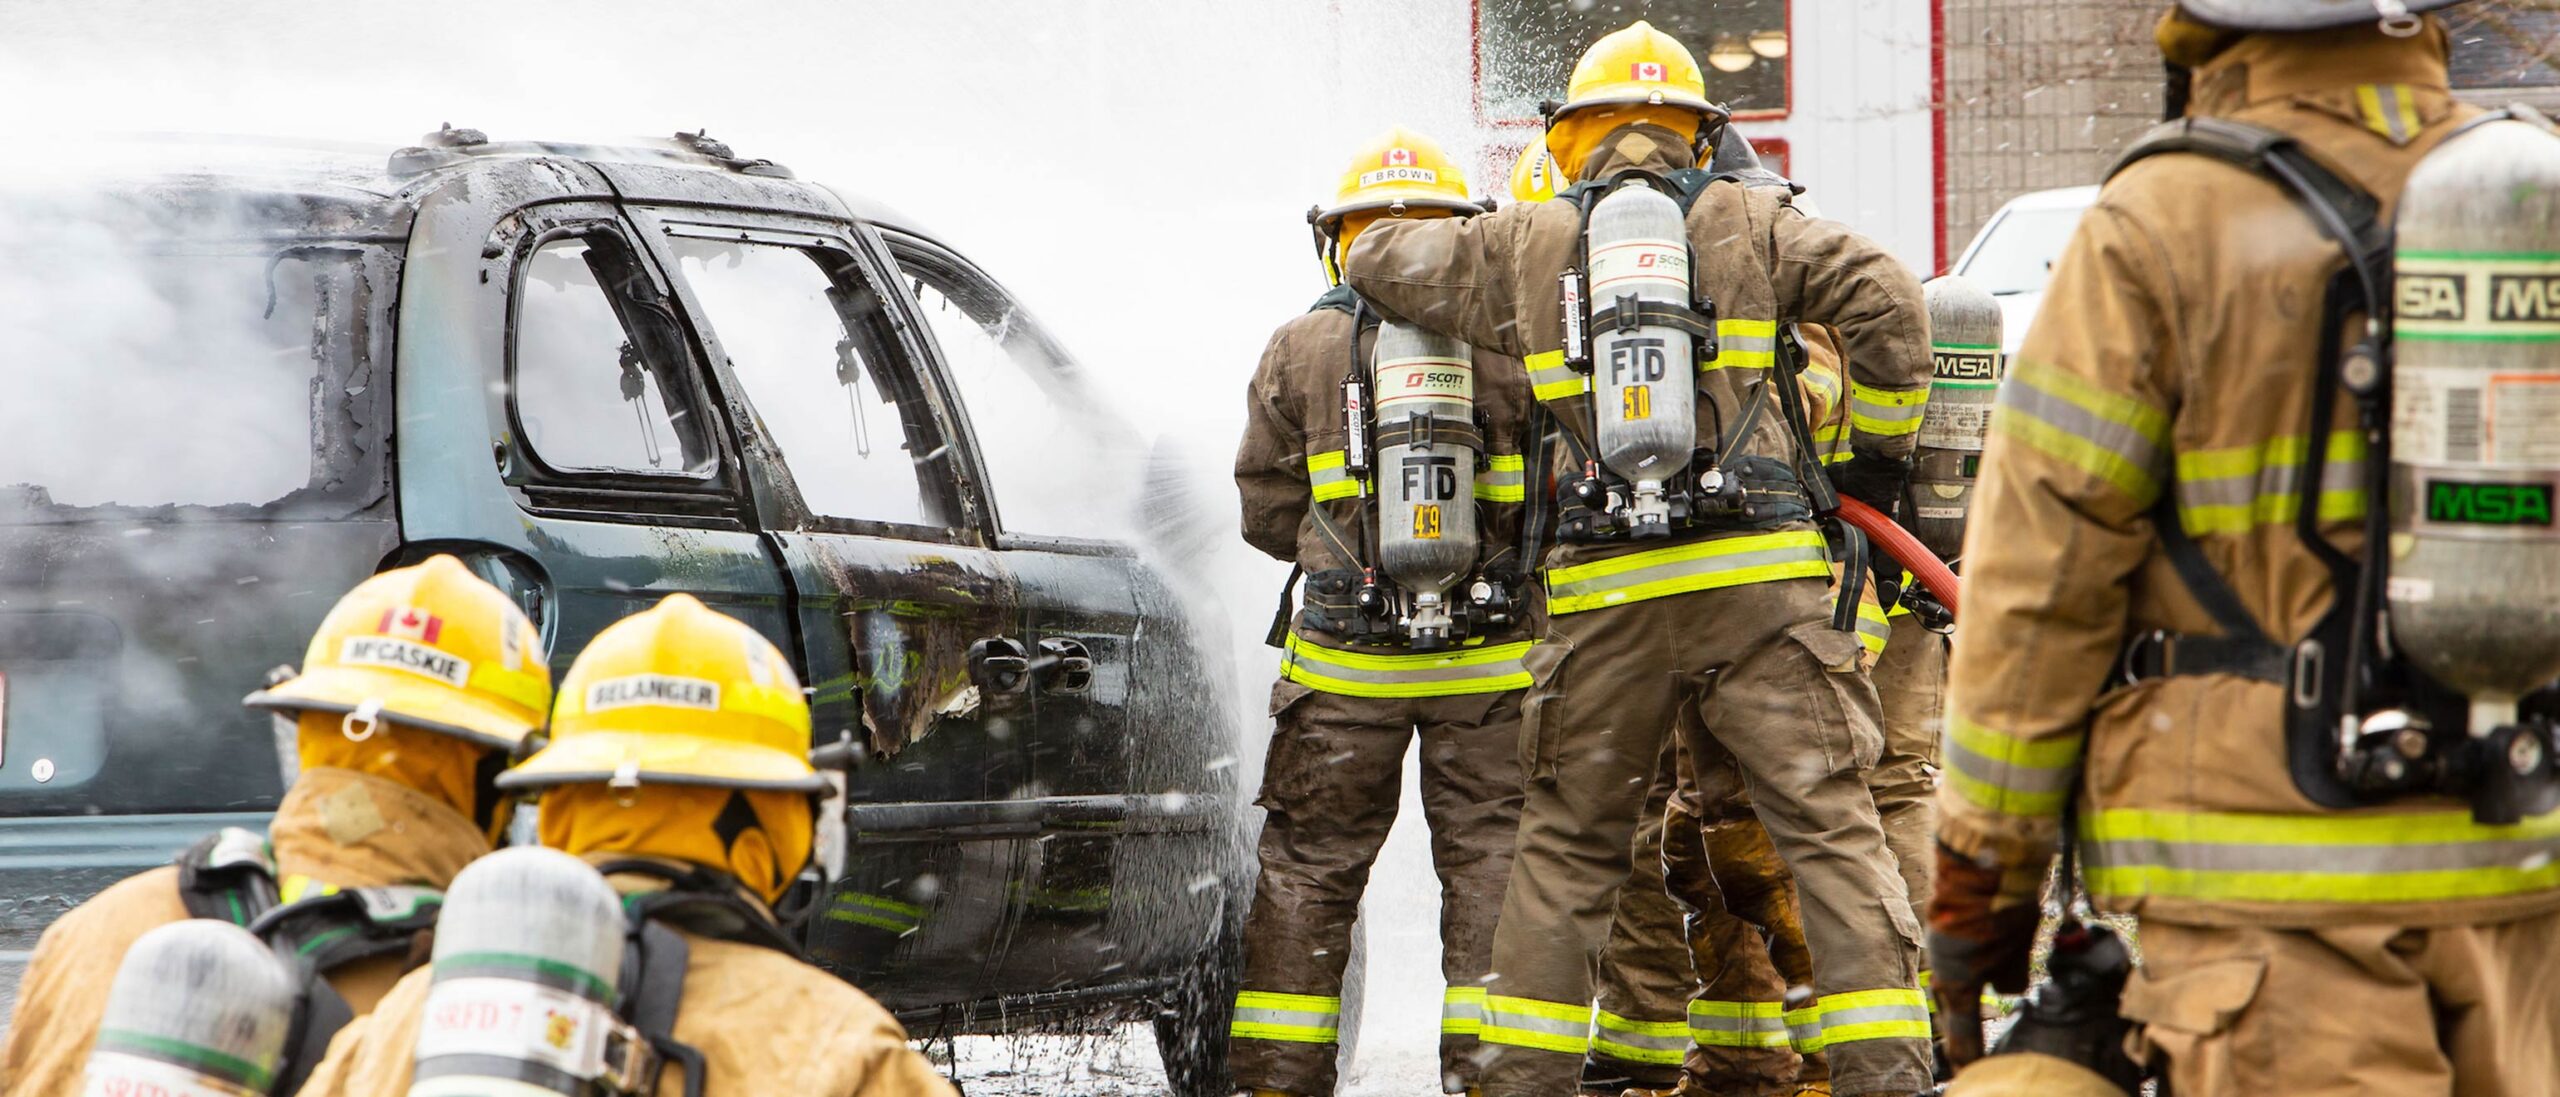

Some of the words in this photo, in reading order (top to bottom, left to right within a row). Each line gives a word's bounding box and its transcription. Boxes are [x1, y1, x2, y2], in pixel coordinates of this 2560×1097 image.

[1376, 168, 1433, 181] BROWN
[1611, 338, 1665, 386] FTD
[1934, 355, 1992, 377] MSA
[1425, 372, 1466, 385] SCOTT
[1624, 385, 1650, 420] 50
[1402, 456, 1456, 501] FTD
[2431, 483, 2550, 524] MSA
[1414, 505, 1440, 535] 49
[594, 678, 713, 705] BELANGER
